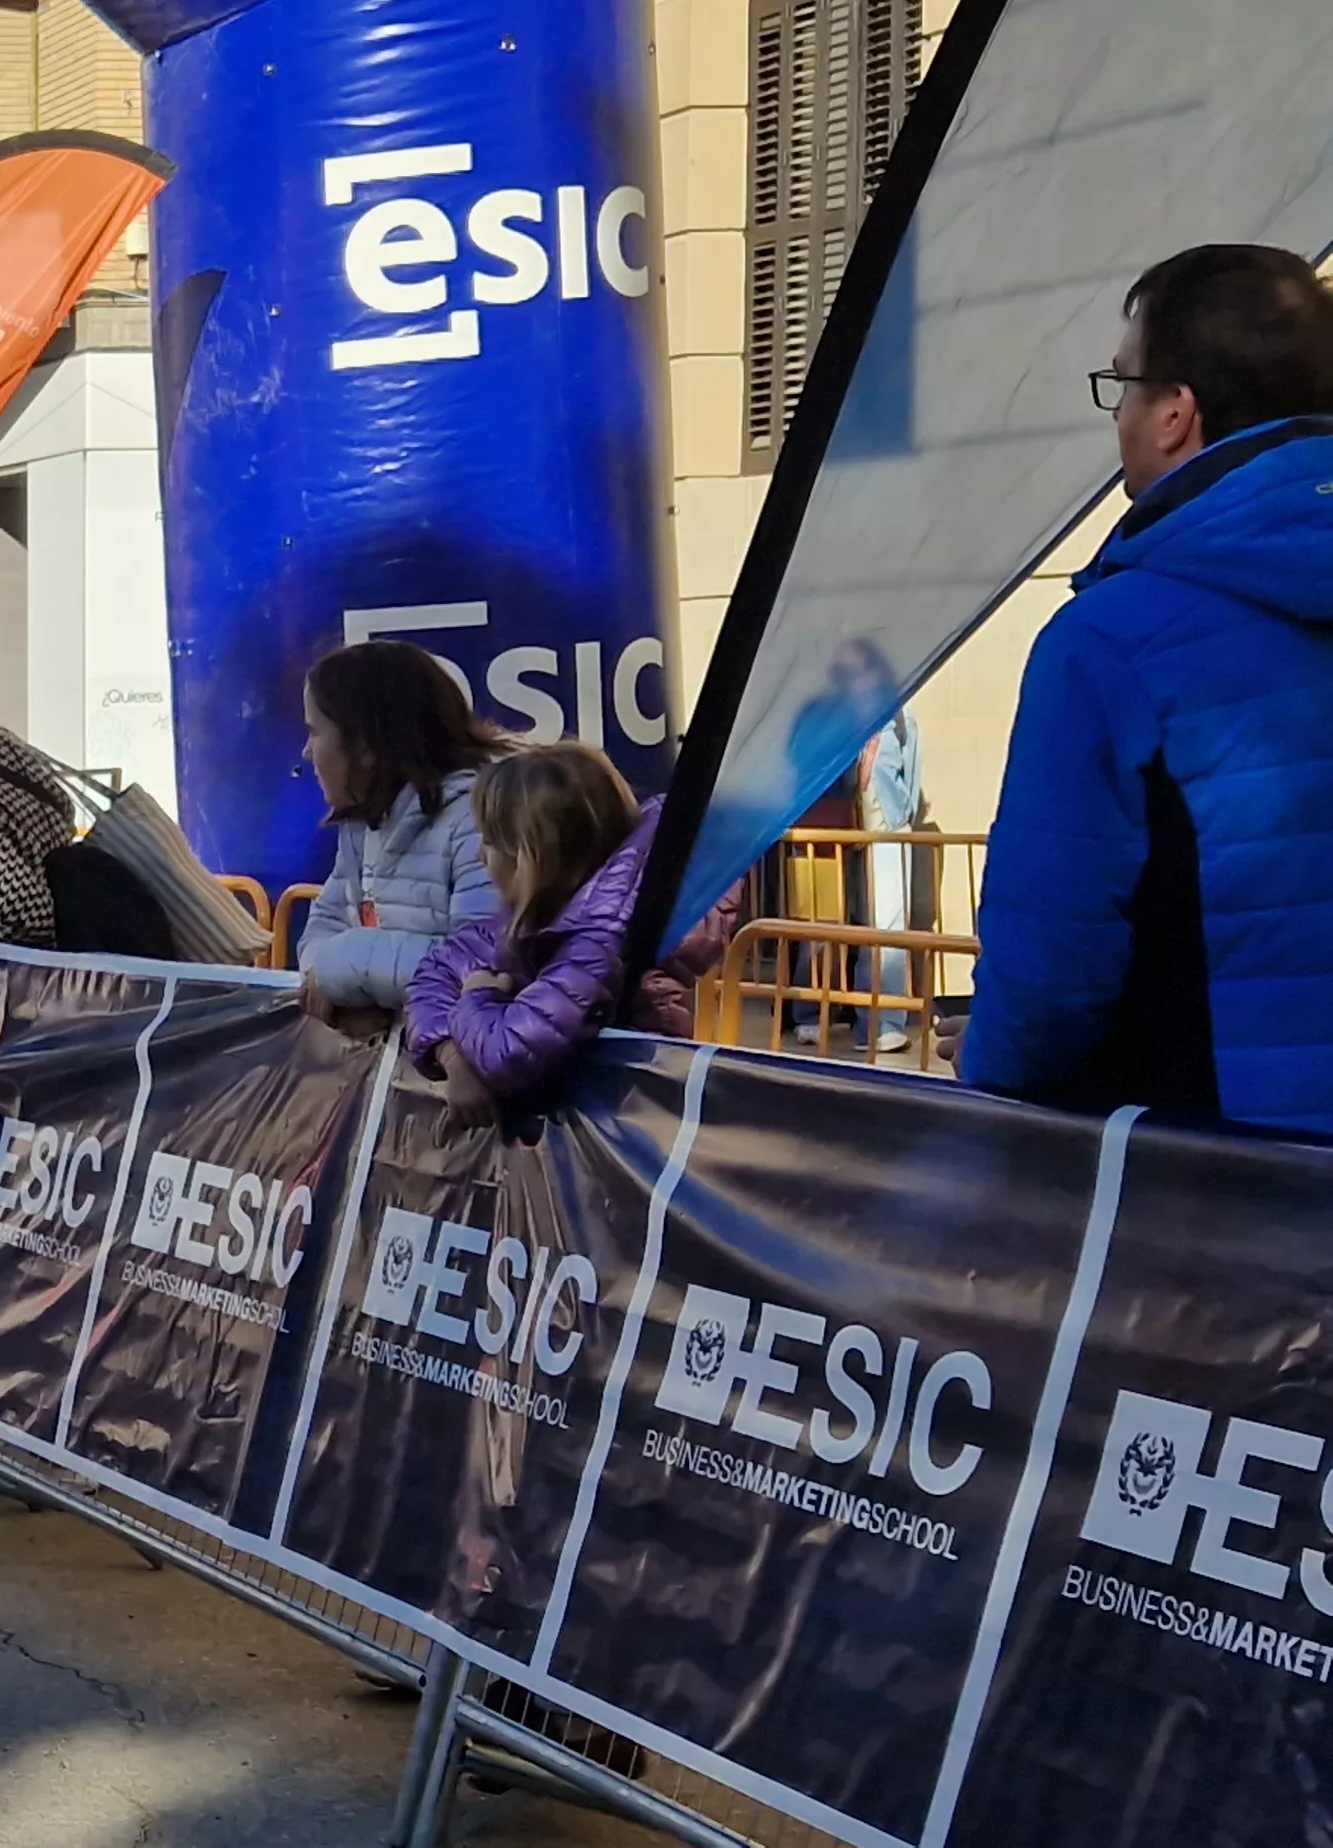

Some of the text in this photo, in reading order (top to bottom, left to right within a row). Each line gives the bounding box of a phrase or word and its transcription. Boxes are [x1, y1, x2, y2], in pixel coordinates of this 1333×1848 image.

[101, 688, 164, 707] ¿Quieres
[174, 1160, 312, 1288] ESIC
[415, 1220, 598, 1376] ESIC
[730, 1302, 992, 1496] ESIC
[641, 1428, 959, 1561] BUSINESS&MARKETINGSCHOOL
